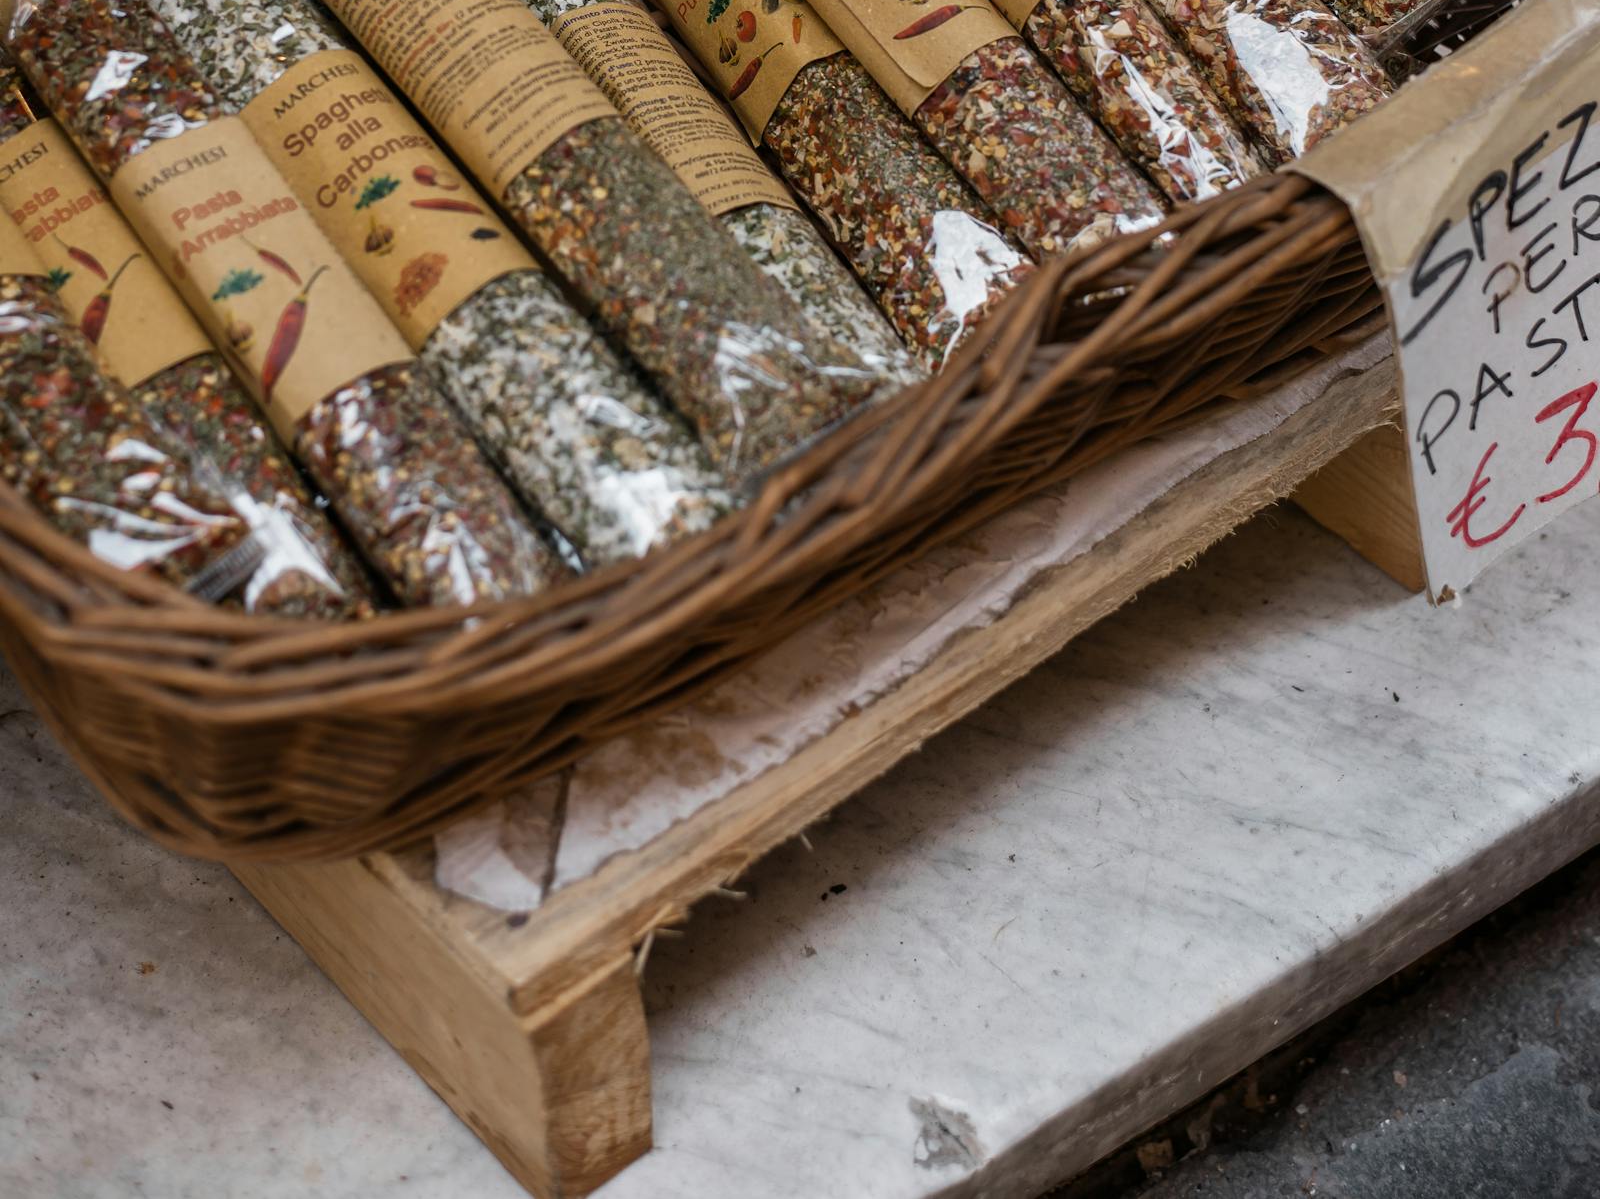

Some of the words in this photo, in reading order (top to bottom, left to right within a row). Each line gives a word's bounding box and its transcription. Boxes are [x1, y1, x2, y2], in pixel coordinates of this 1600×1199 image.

[555, 11, 600, 39] ondimento
[336, 115, 382, 152] alla
[135, 145, 228, 201] MARCHESI
[171, 188, 243, 231] Pasta
[181, 195, 298, 262] Arrabbiata
[1402, 101, 1600, 347] SPEZ
[1483, 193, 1600, 334] PER
[1416, 273, 1600, 475] PAST
